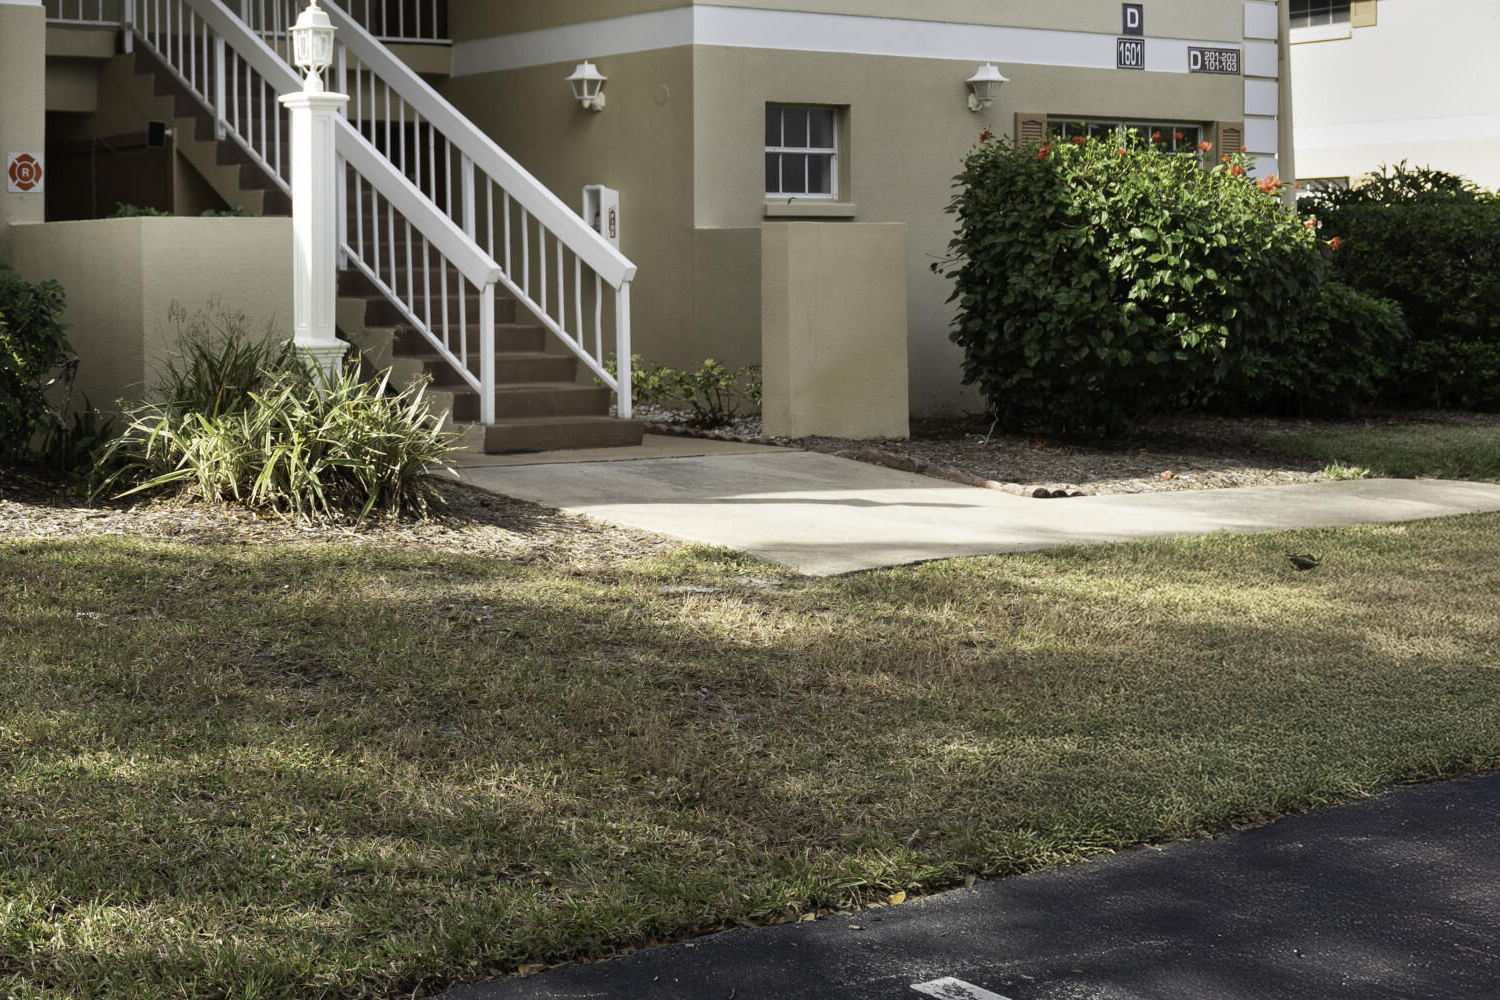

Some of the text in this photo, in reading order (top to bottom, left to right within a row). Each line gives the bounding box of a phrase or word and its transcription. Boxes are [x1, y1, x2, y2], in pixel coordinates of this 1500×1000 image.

[1126, 8, 1139, 28] D
[1119, 42, 1141, 66] 1601
[1190, 50, 1202, 70] D
[1204, 51, 1237, 63] 201-203
[1204, 60, 1237, 72] 101-103
[22, 167, 29, 177] R
